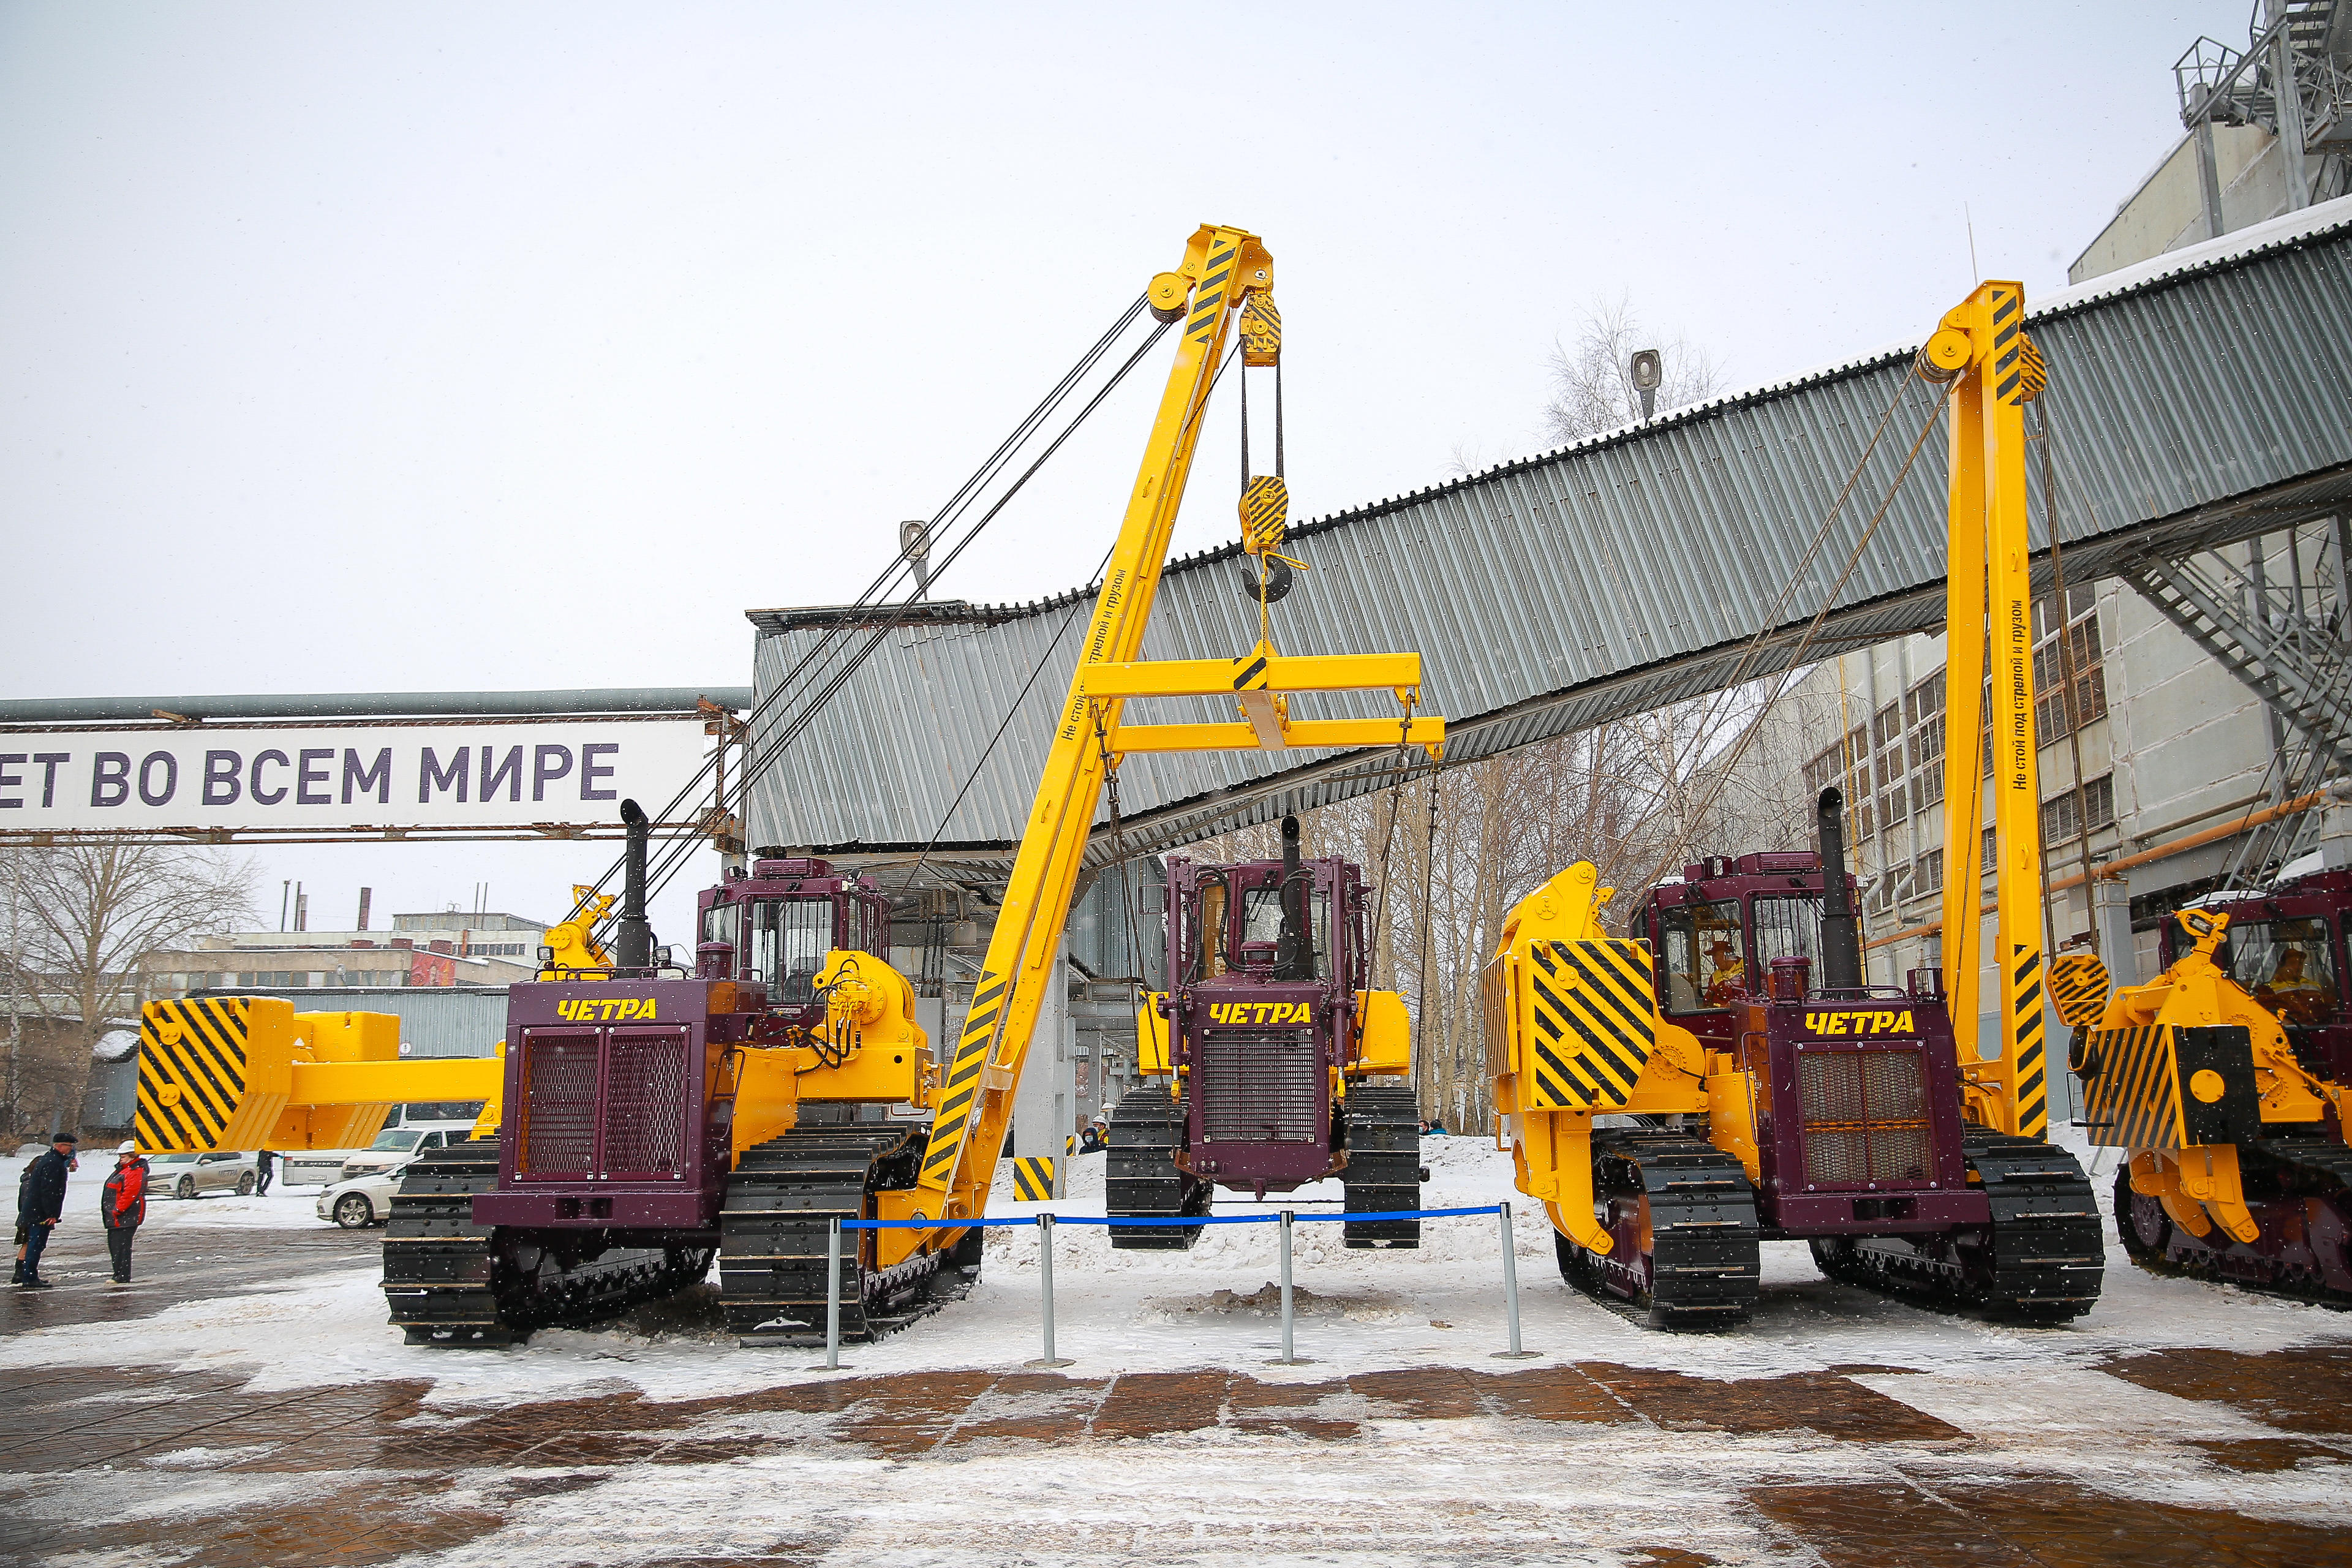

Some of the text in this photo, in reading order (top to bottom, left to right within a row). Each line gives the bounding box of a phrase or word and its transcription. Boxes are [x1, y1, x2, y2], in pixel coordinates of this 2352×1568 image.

[2011, 600, 2027, 643] грузом
[1061, 568, 1126, 741] Не стой трелой и грузом
[2010, 658, 2027, 709] стрелой
[2014, 712, 2027, 737] под
[2011, 740, 2026, 770] стой
[91, 750, 178, 807] ВО
[202, 748, 393, 805] ВСЕМ
[419, 743, 619, 803] МИРЕ
[2013, 773, 2027, 790] Не
[557, 998, 657, 1022] ЧЕТРА
[1209, 1001, 1311, 1024] ЧЕТРА
[1804, 1010, 1915, 1035] ЧЕТРА
